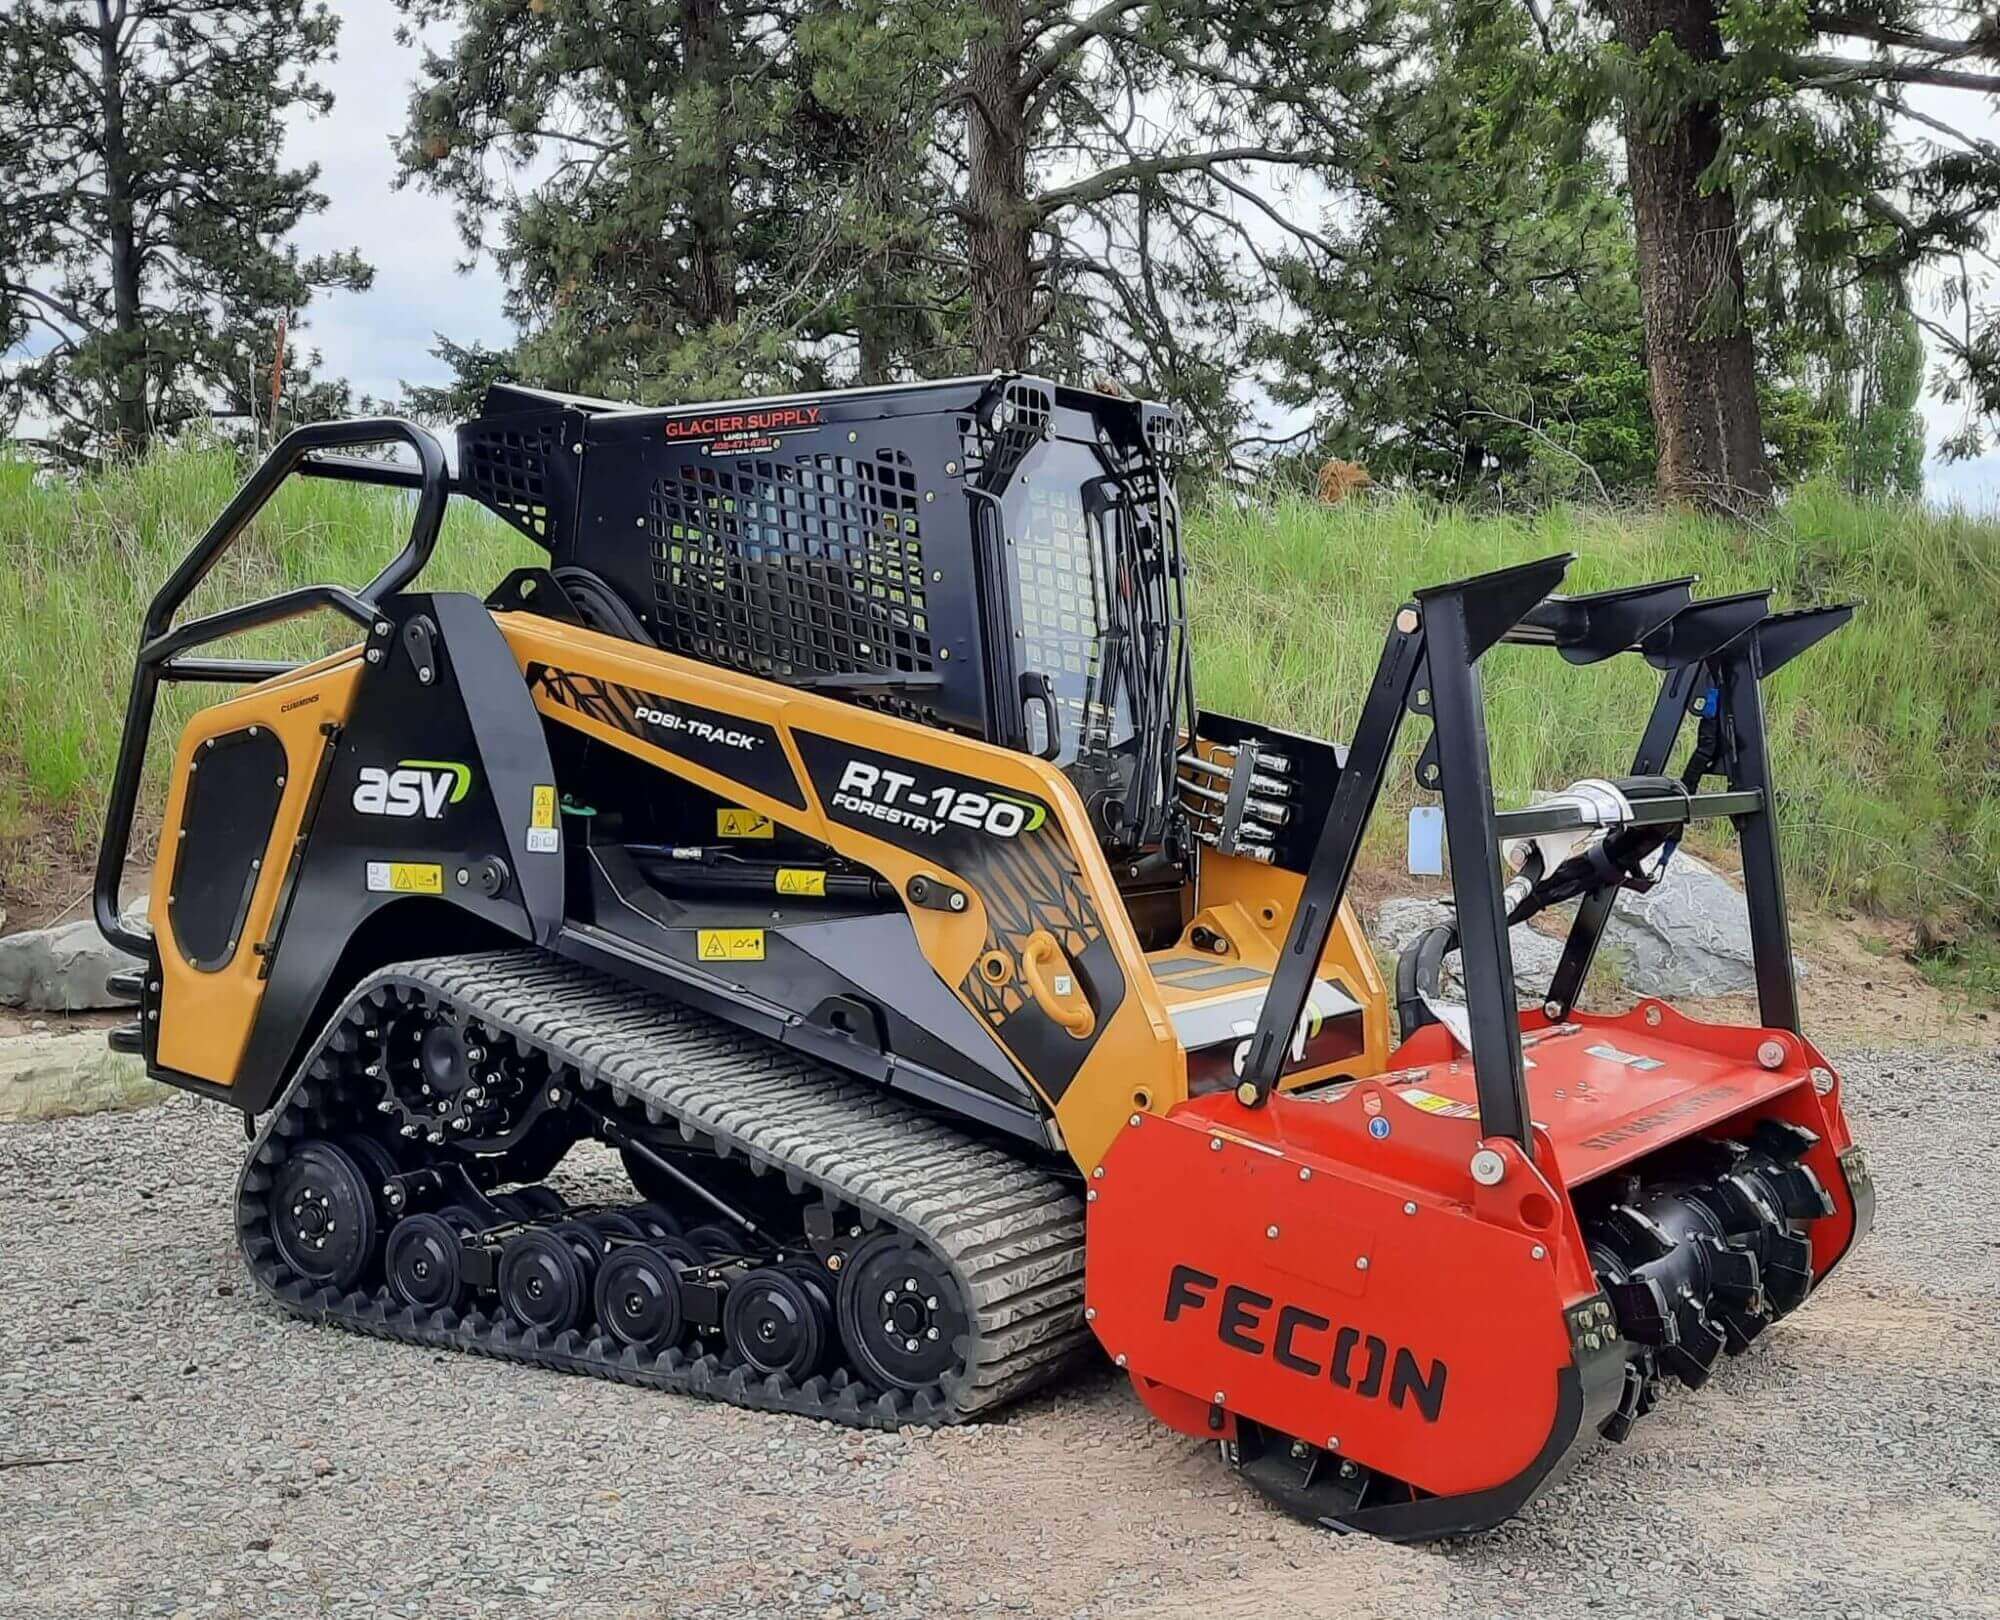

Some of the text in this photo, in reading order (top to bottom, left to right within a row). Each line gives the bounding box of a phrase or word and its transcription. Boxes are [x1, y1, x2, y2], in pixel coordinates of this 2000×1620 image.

[666, 407, 820, 437] GLACIER SUPPLY
[634, 706, 755, 751] POSI-TRACK
[831, 793, 946, 836] FORESTRY
[838, 760, 1025, 838] RT-120
[1163, 1264, 1448, 1423] FECON
